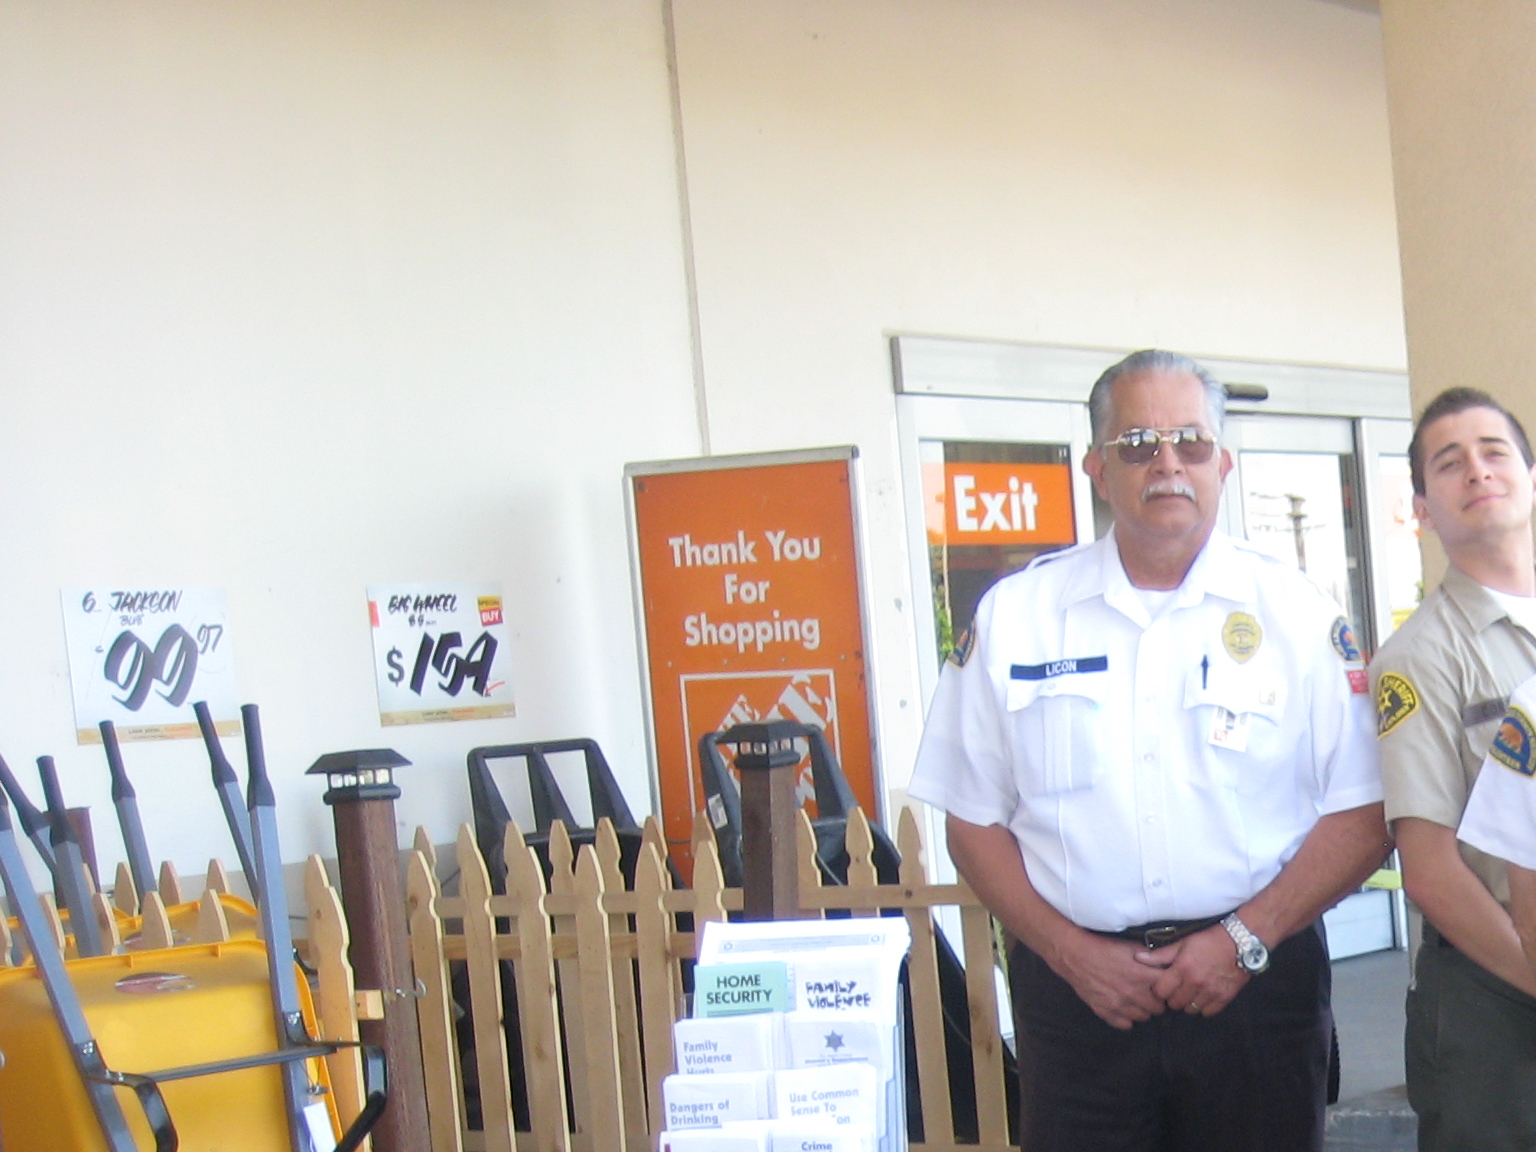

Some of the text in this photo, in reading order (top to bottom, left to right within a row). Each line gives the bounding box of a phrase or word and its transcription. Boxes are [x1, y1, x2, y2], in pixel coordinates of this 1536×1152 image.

[953, 475, 1039, 532] Exit
[668, 530, 821, 568] Thank You
[724, 573, 770, 604] For
[109, 589, 183, 614] JACKSON
[388, 593, 458, 615] BIG WHEEL
[482, 611, 499, 622] BUY
[684, 610, 820, 653] Shopping
[1045, 660, 1078, 677] LICON
[716, 974, 761, 989] HOME
[706, 989, 773, 1005] SECURITY
[683, 1039, 718, 1053] Family
[684, 1051, 732, 1065] Violence
[789, 1087, 859, 1103] Use Common
[669, 1100, 730, 1114] Dangers of
[790, 1102, 837, 1116] Sense To
[670, 1113, 719, 1126] Drinking
[801, 1141, 833, 1151] Crime
